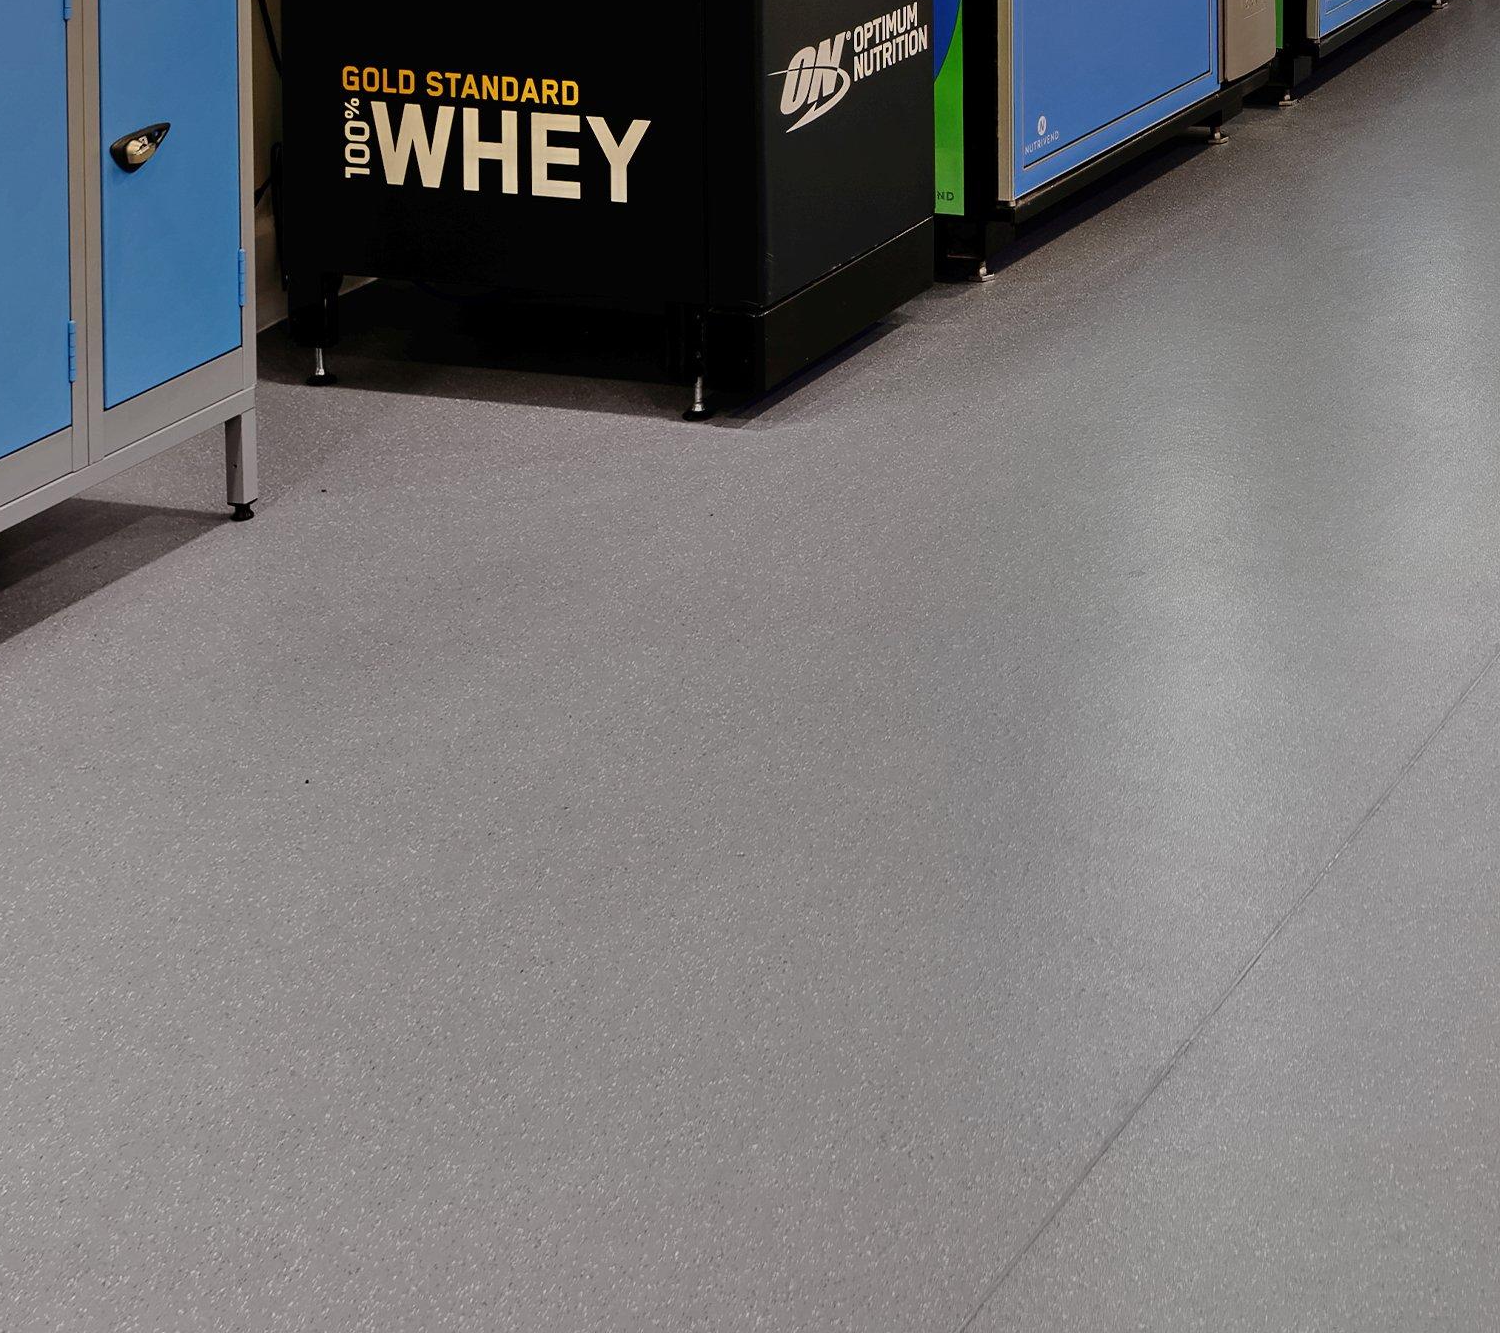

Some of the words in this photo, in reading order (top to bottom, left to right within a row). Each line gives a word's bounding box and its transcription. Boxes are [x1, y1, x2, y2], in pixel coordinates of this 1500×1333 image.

[853, 1, 919, 53] OPTIMUM
[853, 24, 929, 83] NUTRITION
[341, 65, 417, 97] GOLD
[425, 70, 580, 107] STANDARD
[343, 96, 371, 179] 100%
[370, 100, 652, 204] WHEY
[1024, 130, 1060, 155] NUTRIVEND
